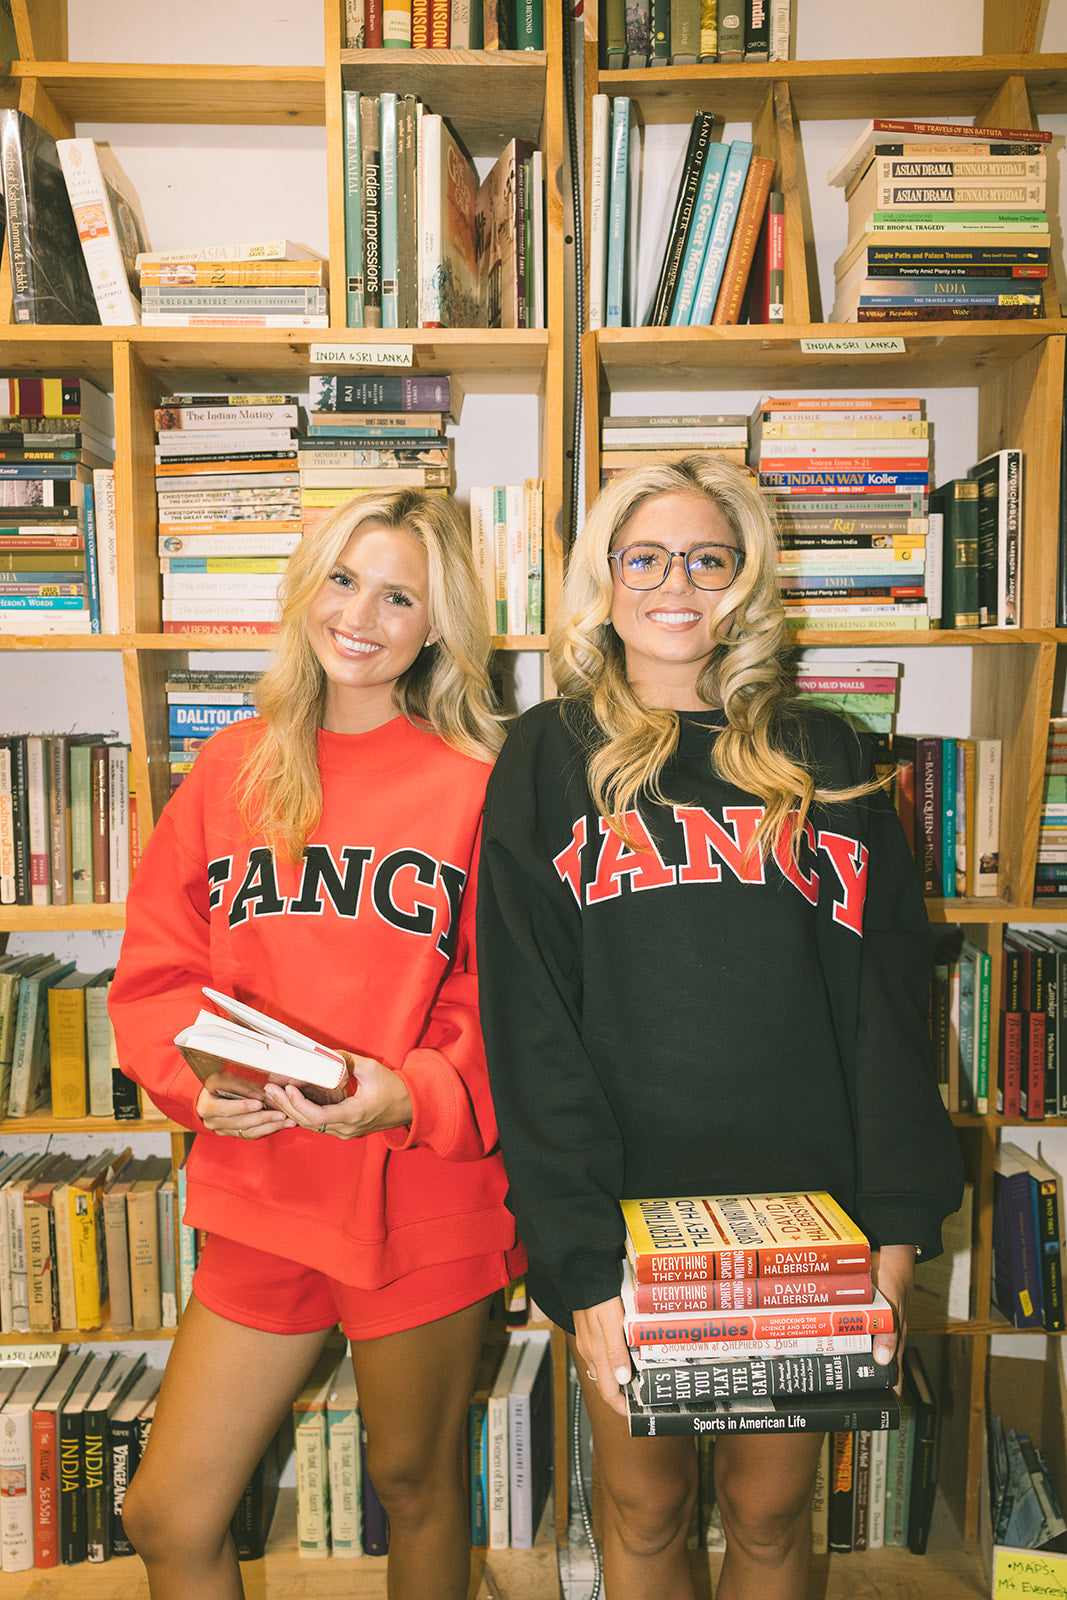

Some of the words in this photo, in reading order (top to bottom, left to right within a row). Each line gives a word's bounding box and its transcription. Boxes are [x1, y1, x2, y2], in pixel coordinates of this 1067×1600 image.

[698, 114, 712, 147] LAND
[930, 125, 954, 133] TRAVELS
[974, 128, 1002, 136] BATTUTA
[694, 150, 704, 166] OF
[688, 170, 700, 192] THE
[894, 164, 922, 176] ASIAN
[922, 164, 952, 176] DRAMA
[954, 164, 988, 175] GUNNAR
[988, 164, 1024, 175] MYRDAL
[366, 164, 380, 206] Indian
[703, 172, 720, 200] The
[724, 169, 743, 198] The
[896, 190, 922, 201] ASIAN
[924, 190, 954, 201] DRAMA
[955, 189, 988, 201] GUNNAR
[989, 189, 1025, 201] MYRDAL
[679, 194, 694, 230] TIGER
[714, 201, 736, 244] Great
[692, 203, 712, 246] Great
[10, 220, 22, 252] Jammu
[740, 224, 754, 264] INDIAN
[364, 210, 380, 292] impressions
[14, 262, 28, 292] Ladakh
[677, 248, 701, 312] Moghuls
[698, 246, 724, 310] Moghuls
[934, 283, 966, 294] INDIA
[806, 342, 834, 350] INDIA
[316, 352, 346, 360] INDIA
[356, 352, 372, 362] SRI
[376, 353, 410, 363] LANKA
[344, 385, 354, 402] RAJ
[186, 411, 204, 421] The
[207, 410, 237, 420] Indian
[239, 410, 274, 420] Mutiny
[810, 458, 832, 466] Voices
[834, 458, 852, 466] from
[106, 474, 114, 488] The
[763, 474, 786, 486] THE
[787, 474, 835, 486] INDIAN
[836, 474, 866, 486] WAY
[868, 474, 898, 484] Koller
[106, 490, 116, 508] Lion
[1009, 461, 1017, 530] UNTOUCHABLES
[107, 508, 115, 531] River
[829, 518, 856, 534] Raj
[825, 578, 855, 587] INDIA
[28, 598, 54, 606] WORDS
[817, 680, 838, 690] MUD
[839, 680, 865, 690] WALLS
[925, 762, 934, 800] BANDIT
[922, 800, 934, 834] QUEEN
[924, 844, 934, 873] INDIA
[675, 1200, 702, 1222] HAD
[766, 1204, 800, 1234] DAVID
[782, 1196, 830, 1242] HALBERSTAM
[639, 1200, 688, 1249] EVERYTHING
[687, 1222, 714, 1248] THEY
[652, 1255, 708, 1272] EVERYTHING
[720, 1252, 732, 1280] SPORTS
[732, 1250, 744, 1280] WRITING
[764, 1262, 830, 1275] HALBERSTAM
[775, 1252, 818, 1264] DAVID
[652, 1272, 680, 1282] THEY
[682, 1270, 708, 1280] HAD
[652, 1285, 708, 1301] EVERYTHING
[720, 1282, 732, 1309] SPORTS
[732, 1280, 744, 1310] WRITING
[764, 1293, 829, 1306] HALBERSTAM
[774, 1282, 817, 1295] DAVID
[652, 1302, 681, 1312] THEY
[682, 1300, 708, 1310] HAD
[639, 1320, 749, 1342] intangibles
[769, 1317, 802, 1325] UNLOCKING
[838, 1316, 863, 1325] JOAN
[838, 1324, 863, 1333] RYAN
[774, 1338, 798, 1350] BUSH
[28, 1350, 58, 1361] LANKA
[674, 1368, 691, 1400] HOW
[694, 1370, 710, 1397] YOU
[712, 1366, 730, 1397] PLAY
[732, 1366, 748, 1394] THE
[750, 1360, 768, 1396] GAME
[826, 1363, 834, 1386] BRIAN
[834, 1356, 844, 1391] KILMEADE
[656, 1372, 672, 1400] IT'S
[648, 1416, 656, 1436] Davies
[693, 1417, 726, 1432] Sports
[727, 1417, 737, 1430] in
[739, 1416, 785, 1429] American
[787, 1415, 807, 1428] Life
[494, 1433, 504, 1468] Women
[61, 1438, 79, 1492] INDIA
[85, 1436, 103, 1489] INDIA
[113, 1444, 129, 1516] VENGEANCE
[495, 1469, 504, 1480] of
[495, 1480, 504, 1496] the
[40, 1487, 51, 1525] SEASON
[494, 1497, 504, 1512] Raj
[1012, 1562, 1050, 1576] MAPS
[998, 1579, 1015, 1589] Mt
